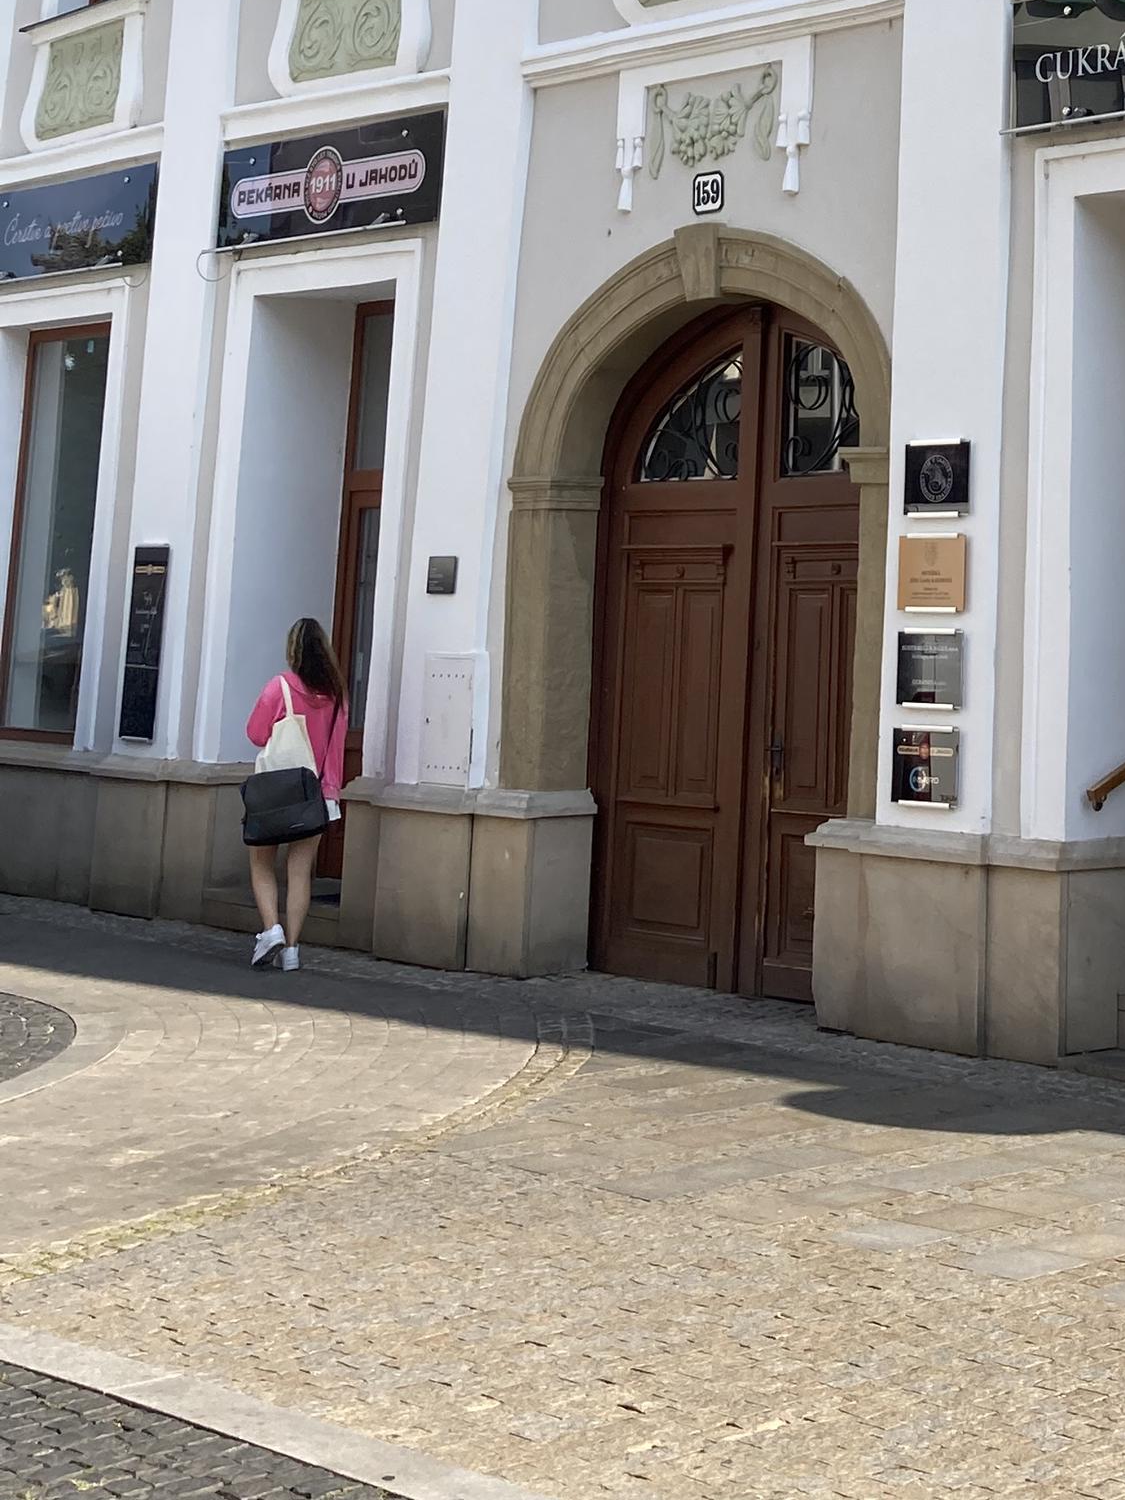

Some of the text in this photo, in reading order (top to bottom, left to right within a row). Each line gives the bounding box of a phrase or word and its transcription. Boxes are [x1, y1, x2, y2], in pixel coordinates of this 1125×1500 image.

[237, 179, 301, 206] PEKÁRNA
[346, 177, 355, 190] U
[310, 173, 337, 194] 1911
[695, 178, 720, 207] 159
